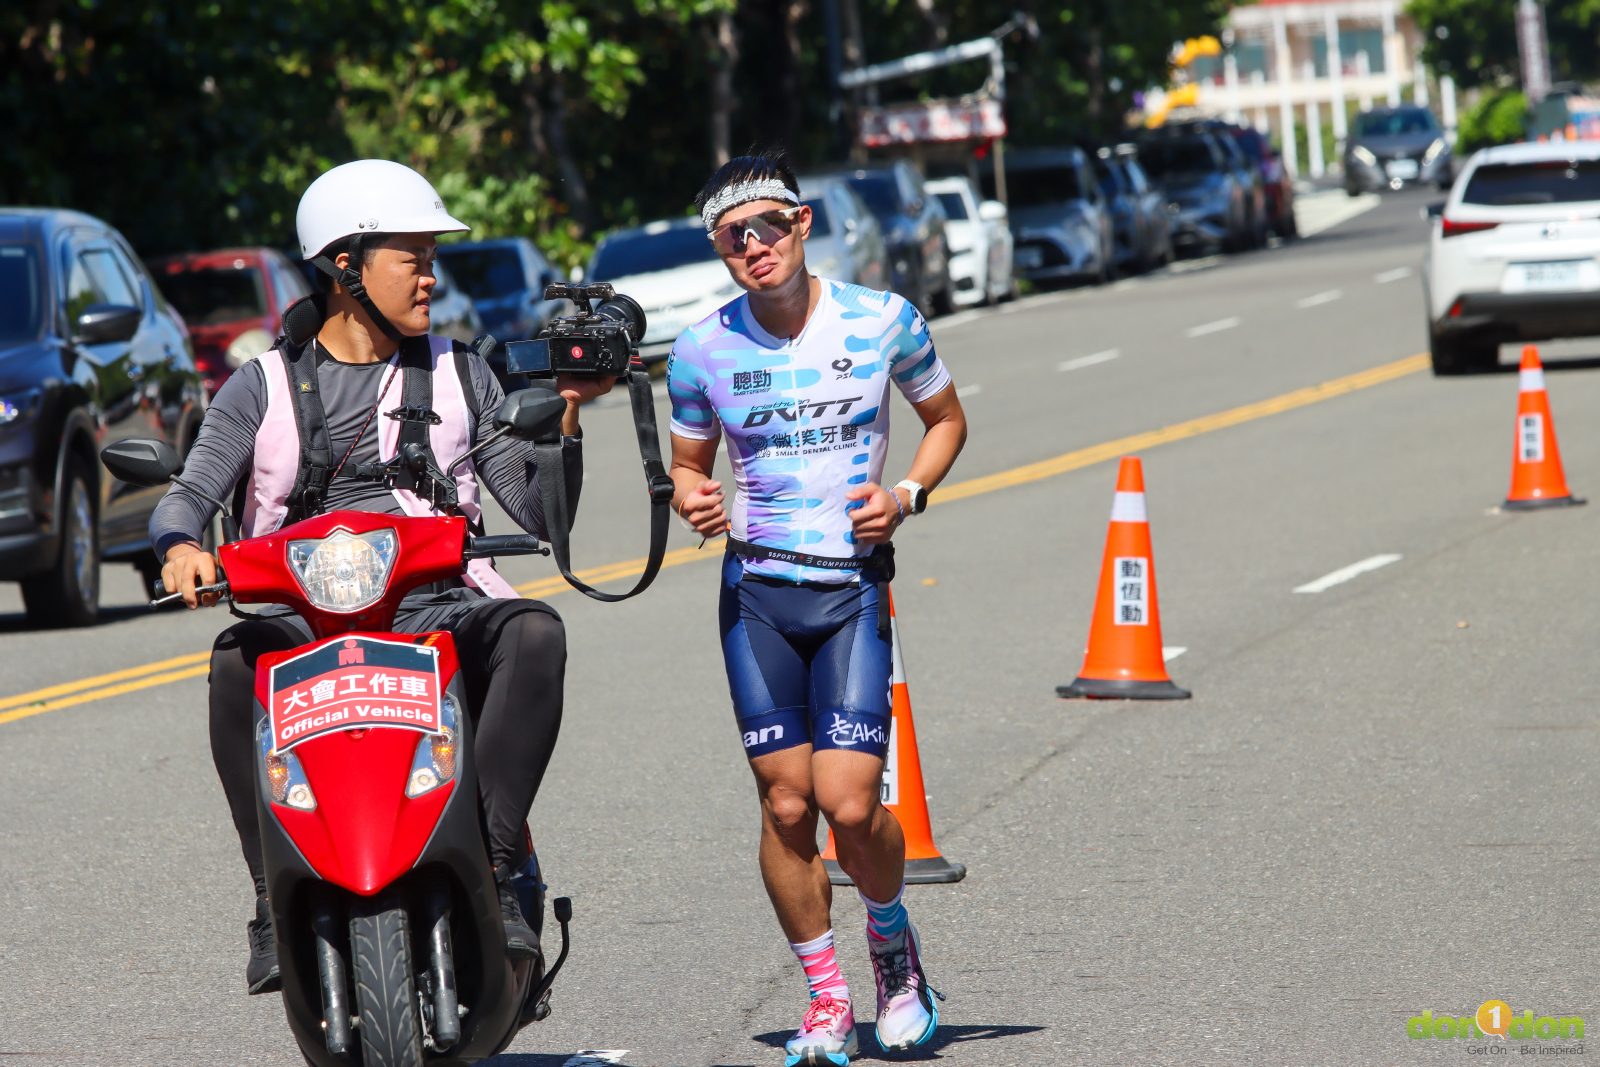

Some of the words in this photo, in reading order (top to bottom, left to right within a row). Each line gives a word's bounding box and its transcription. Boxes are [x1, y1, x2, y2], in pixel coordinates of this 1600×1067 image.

[771, 424, 859, 449] 微笑牙醫
[802, 446, 832, 455] DENTAL
[833, 441, 858, 451] CLINIC
[283, 673, 429, 715] 大會工作車
[281, 707, 349, 740] Official
[355, 705, 433, 723] Vehicle
[743, 724, 784, 748] an
